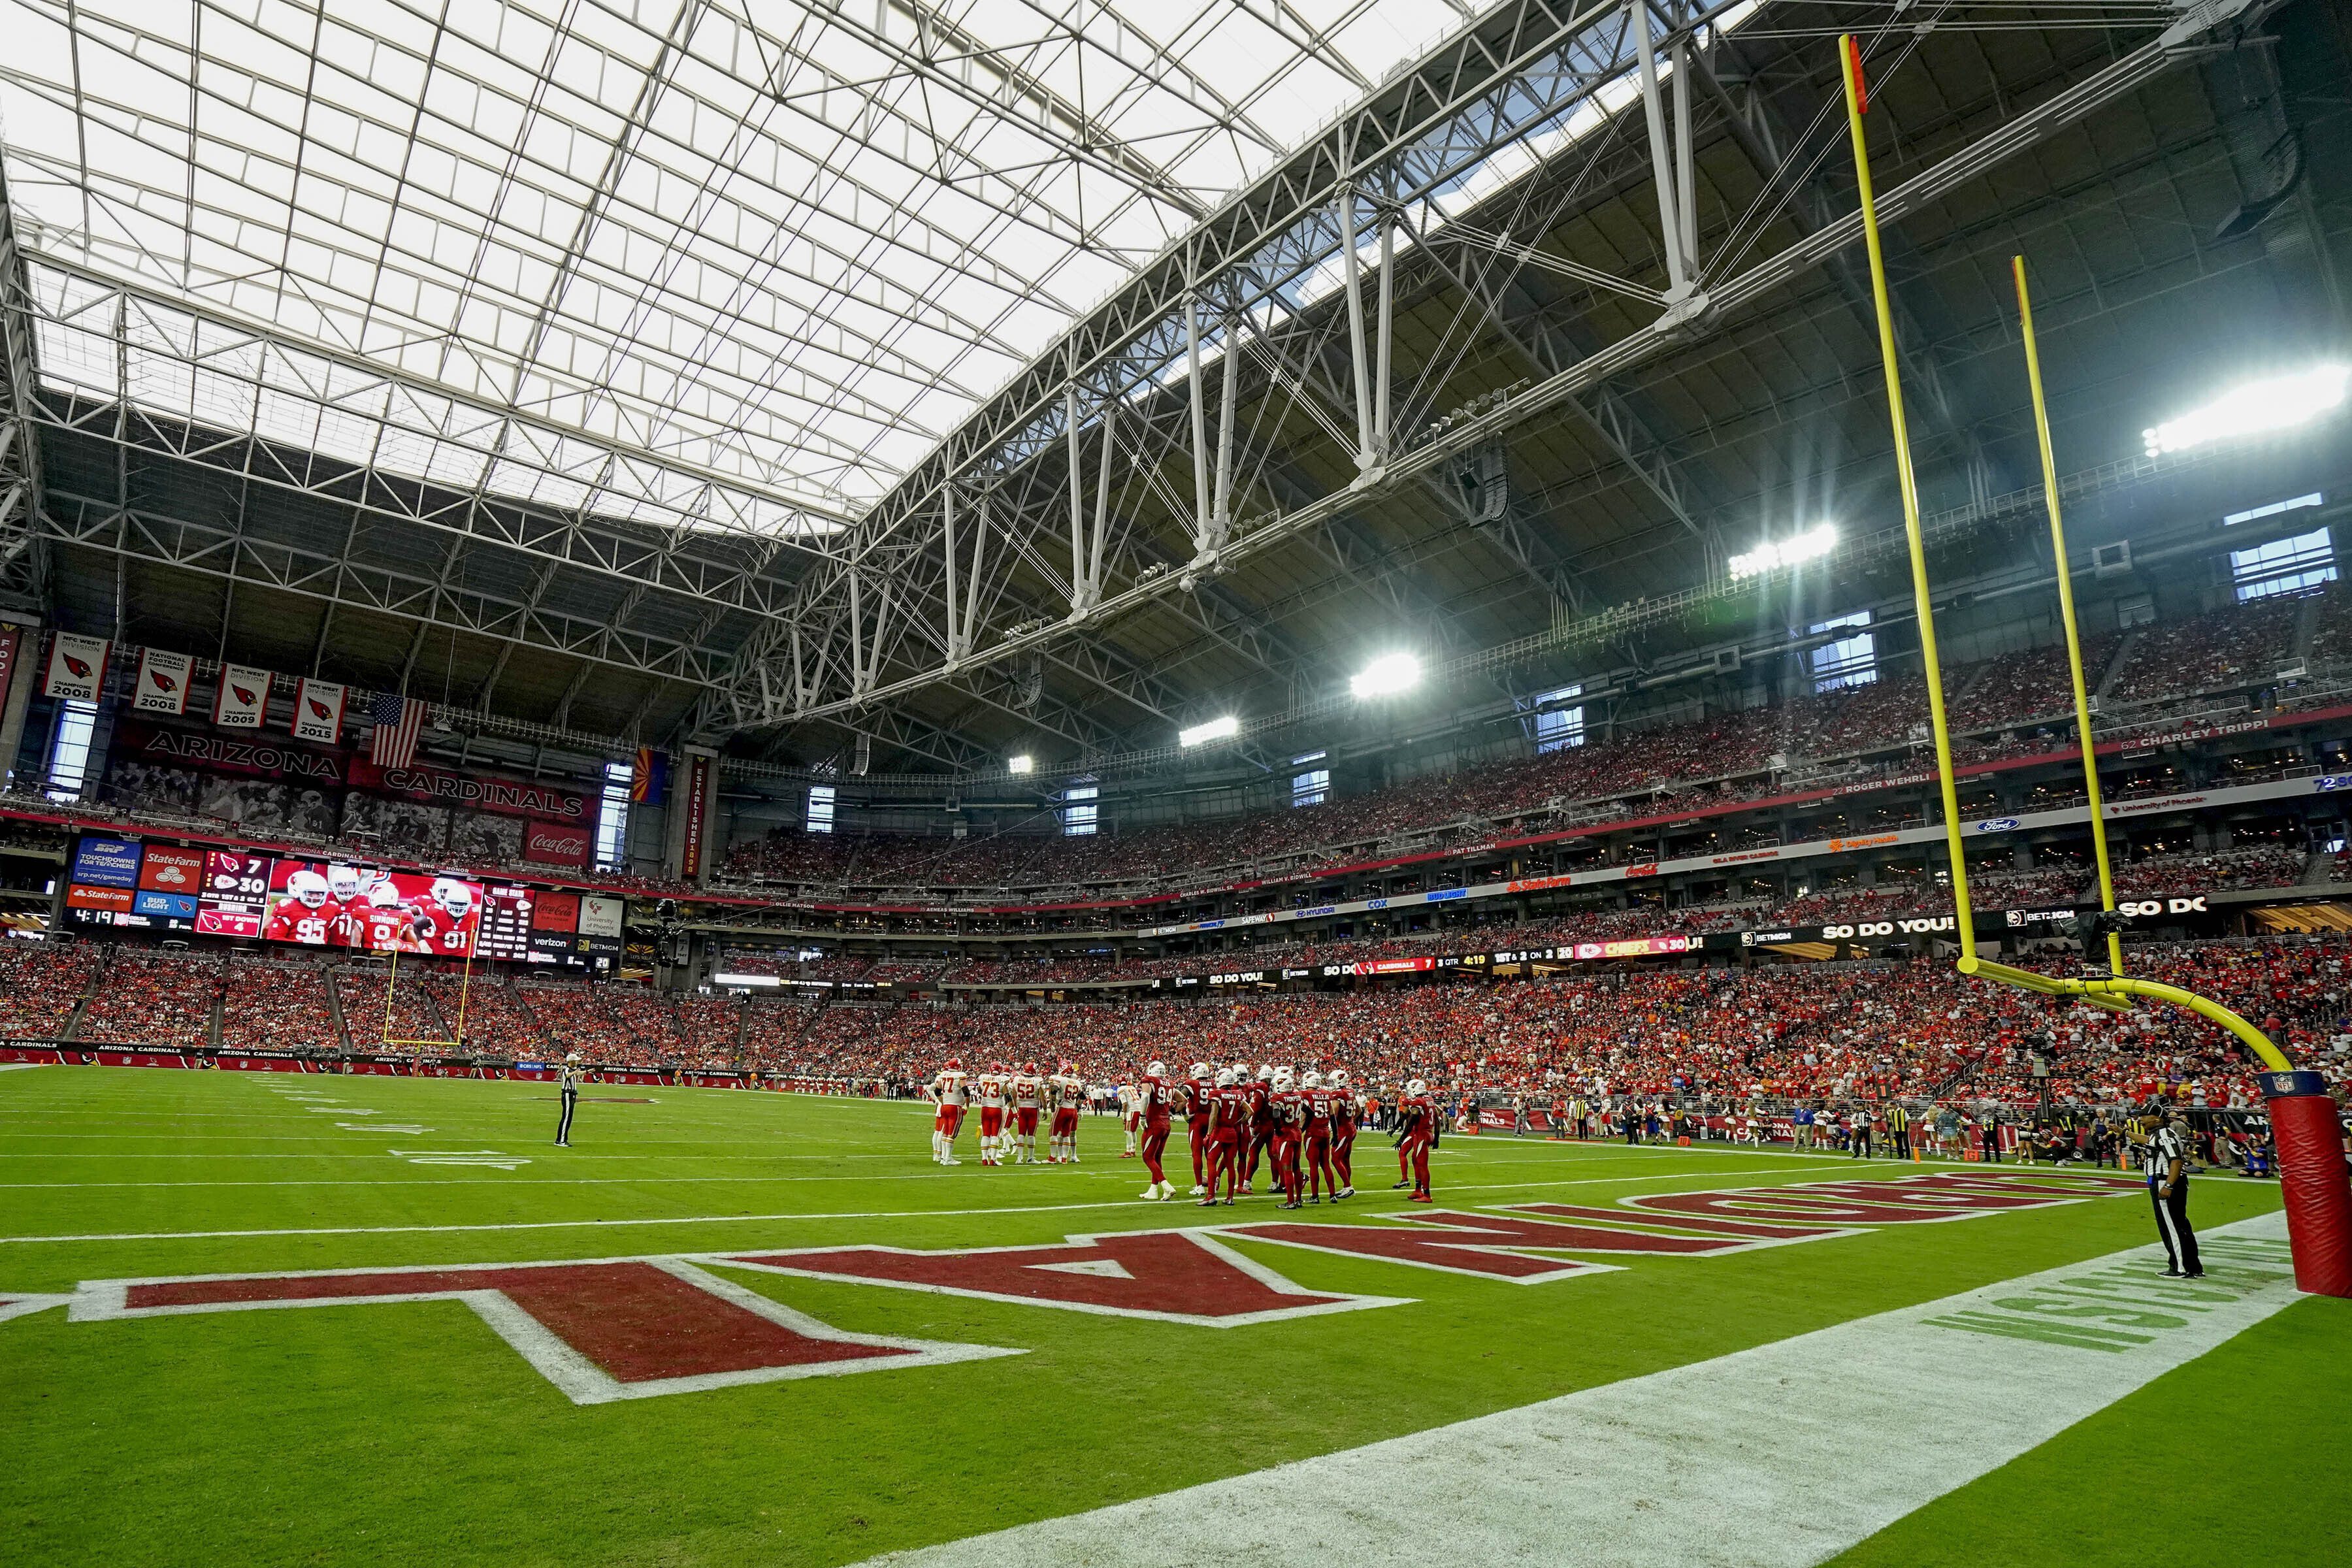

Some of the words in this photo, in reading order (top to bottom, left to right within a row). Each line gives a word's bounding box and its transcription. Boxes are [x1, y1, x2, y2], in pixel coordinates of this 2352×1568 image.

[63, 636, 78, 644] NFC
[61, 641, 100, 652] DIVISION
[149, 657, 185, 668] FOOTBALL
[150, 652, 186, 663] NATIONAL
[148, 661, 184, 671] CONFERENCE
[230, 673, 264, 683] DIVISION
[54, 680, 91, 690] CHAMPIONS
[52, 686, 91, 698] 2008
[142, 693, 177, 702] CHAMPIONS
[307, 687, 338, 698] DIVISION
[140, 698, 176, 710] 2008
[223, 715, 255, 724] 2009
[302, 721, 332, 730] CHAMPIONS
[300, 727, 331, 739] 2015
[2121, 740, 2136, 750] 62
[2140, 728, 2211, 747] CHARLEY
[2215, 719, 2269, 735] TRIPPI
[145, 731, 340, 779] ARIZONA
[1833, 787, 1844, 796] 22
[1846, 781, 1883, 793] ROGER
[1886, 773, 1931, 786] WEHRLI
[384, 769, 583, 817] CARDINALS
[689, 768, 703, 844] ESTABLISHED
[2122, 801, 2163, 813] University
[2172, 796, 2204, 806] Phoenix
[1984, 820, 2011, 831] Ford
[530, 833, 586, 857] Coca-Cola
[1846, 838, 1872, 849] Dignity
[1872, 835, 1899, 844] Health
[94, 843, 125, 853] SRP
[1467, 843, 1495, 853] TILLMAN
[81, 854, 136, 865] TOUCHDOWNS
[322, 850, 363, 860] CARDINALS
[1749, 851, 1779, 860] CASINOS
[95, 860, 135, 870] TEACHERS
[248, 860, 261, 874] 7
[77, 872, 132, 883] srp.net/gameday
[238, 877, 265, 894] 30
[1428, 892, 1443, 902] BUD
[1444, 889, 1467, 900] LIGHT
[1368, 900, 1388, 909] COX
[2118, 900, 2162, 918] SO
[1307, 906, 1335, 915] HYUNDAI
[76, 909, 112, 924] 4:19
[369, 915, 399, 925] SIMMONS
[587, 916, 614, 925] University
[1242, 915, 1267, 924] SAFEWAY
[234, 923, 244, 932] 4
[296, 920, 326, 941] 95
[1822, 924, 1855, 940] SO
[1859, 922, 1894, 937] DO
[1897, 916, 1955, 934] YOU!
[444, 931, 466, 949] 91
[1757, 932, 1791, 941] BETMGM
[534, 938, 567, 948] verizon
[590, 943, 619, 952] BETMGM
[1605, 941, 1650, 956] CHIEFS
[1669, 939, 1685, 951] 30
[1445, 957, 1459, 966] QTR
[1463, 955, 1486, 966] 4:19
[1495, 953, 1511, 963] 1ST
[1520, 951, 1527, 962] 2
[1530, 951, 1542, 960] ON
[1545, 949, 1554, 959] 2
[1558, 947, 1573, 958] 20
[597, 958, 608, 967] 20
[1377, 961, 1415, 970] CARDINALS
[1425, 959, 1431, 968] 7
[1324, 966, 1339, 976] SO
[1209, 974, 1222, 984] SO
[1224, 973, 1239, 983] DO
[1241, 972, 1263, 982] YOU!
[942, 1077, 954, 1093] 77
[983, 1081, 1000, 1098] 73
[1880, 1085, 1886, 1096] 1
[1017, 1083, 1035, 1099] 52
[1064, 1085, 1079, 1100] 62
[1156, 1086, 1173, 1106] 94
[1228, 1101, 1235, 1119] 7
[1284, 1104, 1301, 1123] 34
[1314, 1101, 1328, 1118] 51
[1428, 1110, 1434, 1125] 3
[387, 1149, 532, 1166] 10
[1967, 1151, 1976, 1160] G
[1918, 1258, 2296, 1354] RACISM
